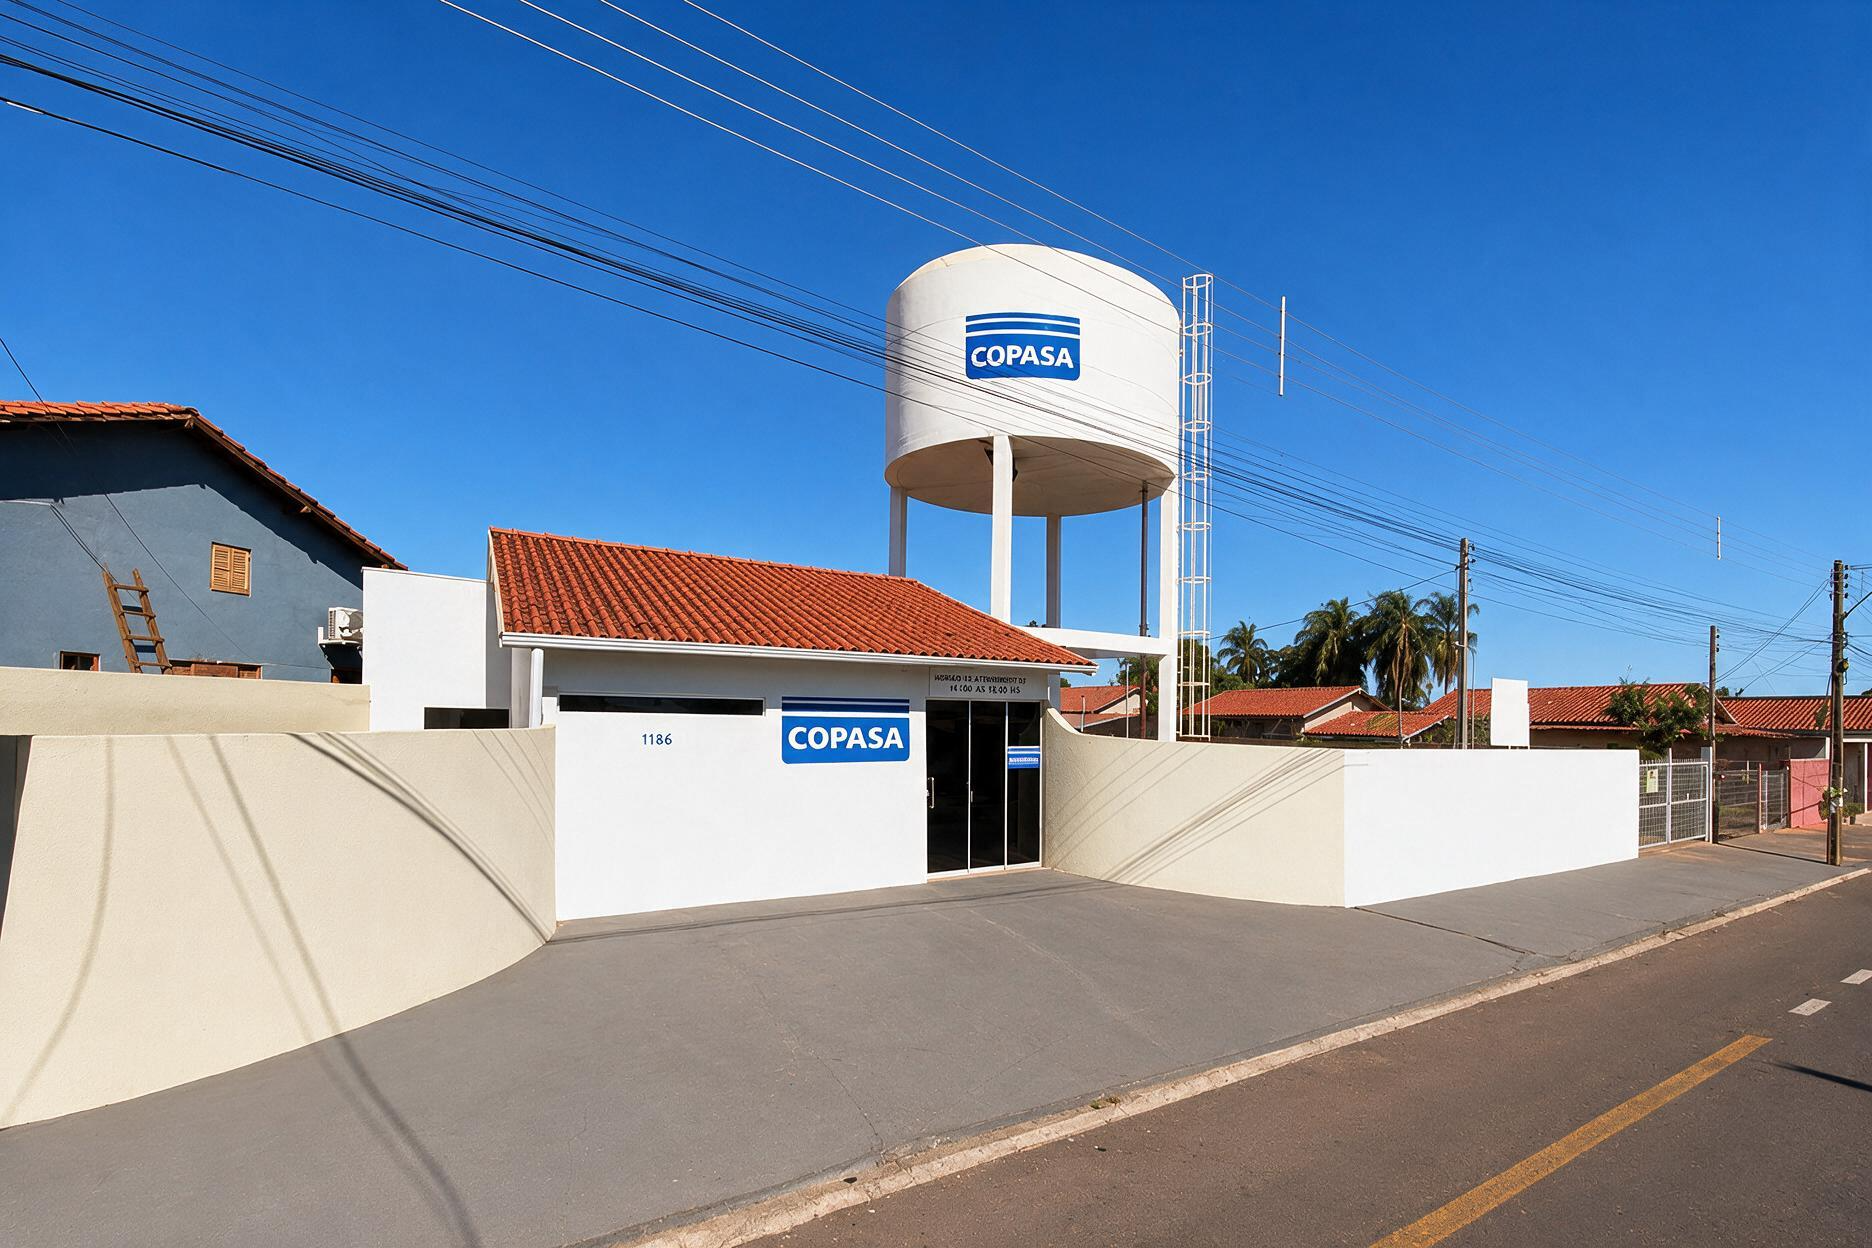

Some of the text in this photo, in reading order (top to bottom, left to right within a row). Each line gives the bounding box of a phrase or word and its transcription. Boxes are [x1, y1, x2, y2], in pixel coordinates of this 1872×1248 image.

[971, 345, 1074, 368] COPASA
[642, 733, 673, 746] 1186
[788, 726, 904, 750] COPASA
